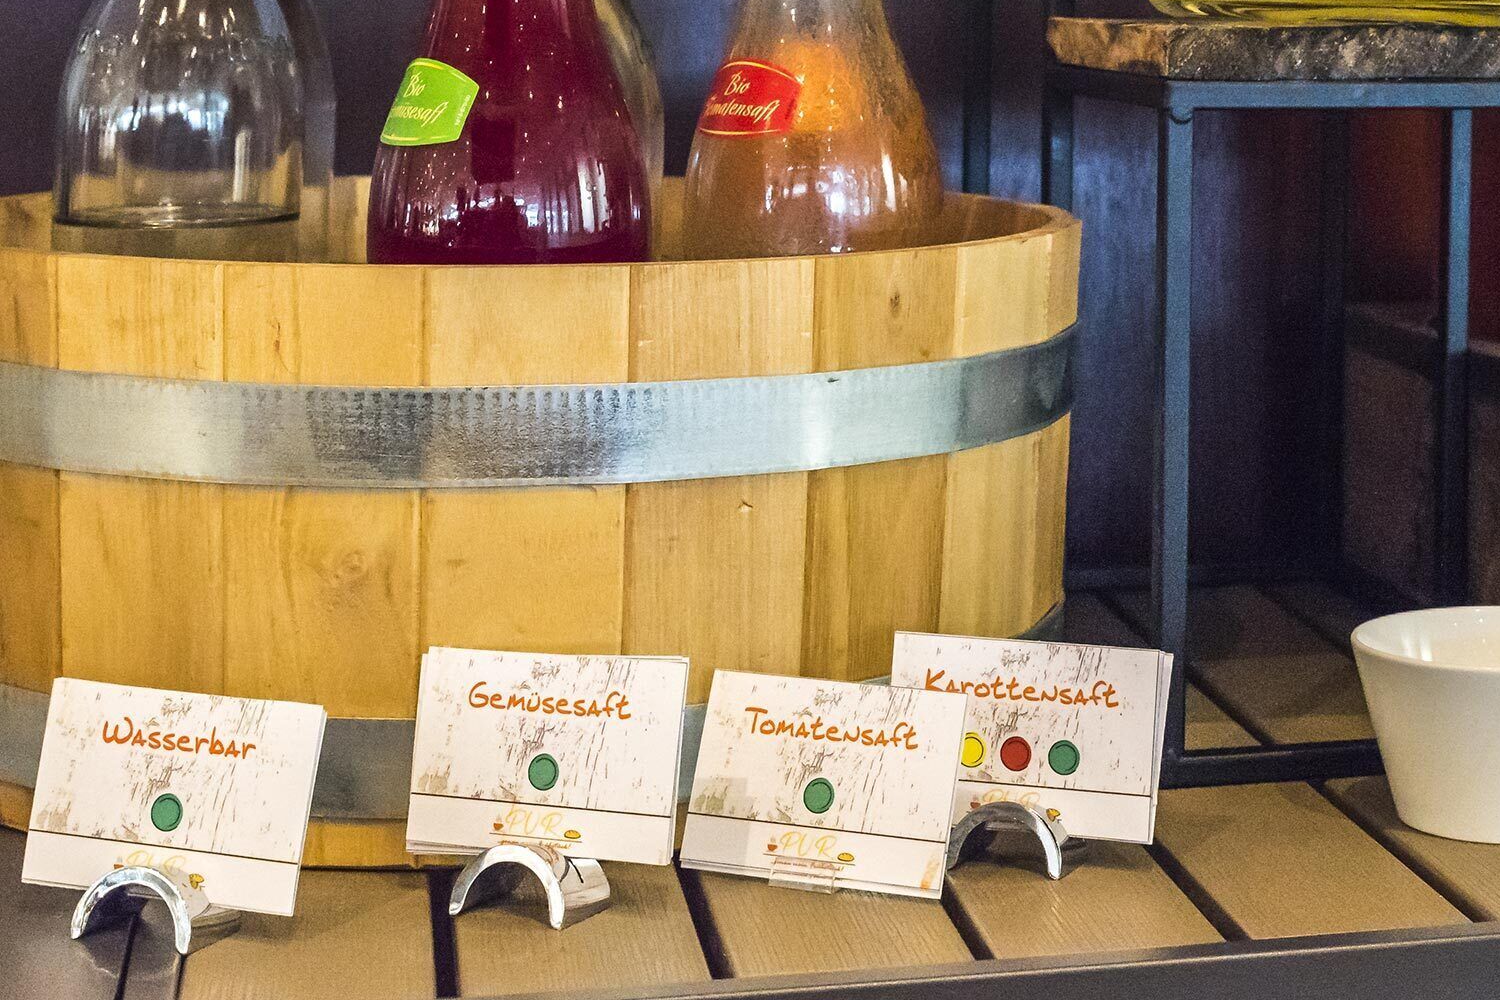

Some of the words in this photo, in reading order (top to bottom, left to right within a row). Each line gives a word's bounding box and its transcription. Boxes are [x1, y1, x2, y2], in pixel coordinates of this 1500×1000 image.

[403, 71, 426, 98] Bio
[723, 70, 751, 96] Bio
[468, 680, 633, 721] Gemüsesaft
[925, 668, 1120, 708] Karottensaft
[102, 717, 257, 760] Wasserbar
[744, 706, 919, 751] Tomatensaft
[505, 808, 564, 837] PUR
[779, 831, 837, 860] PUR
